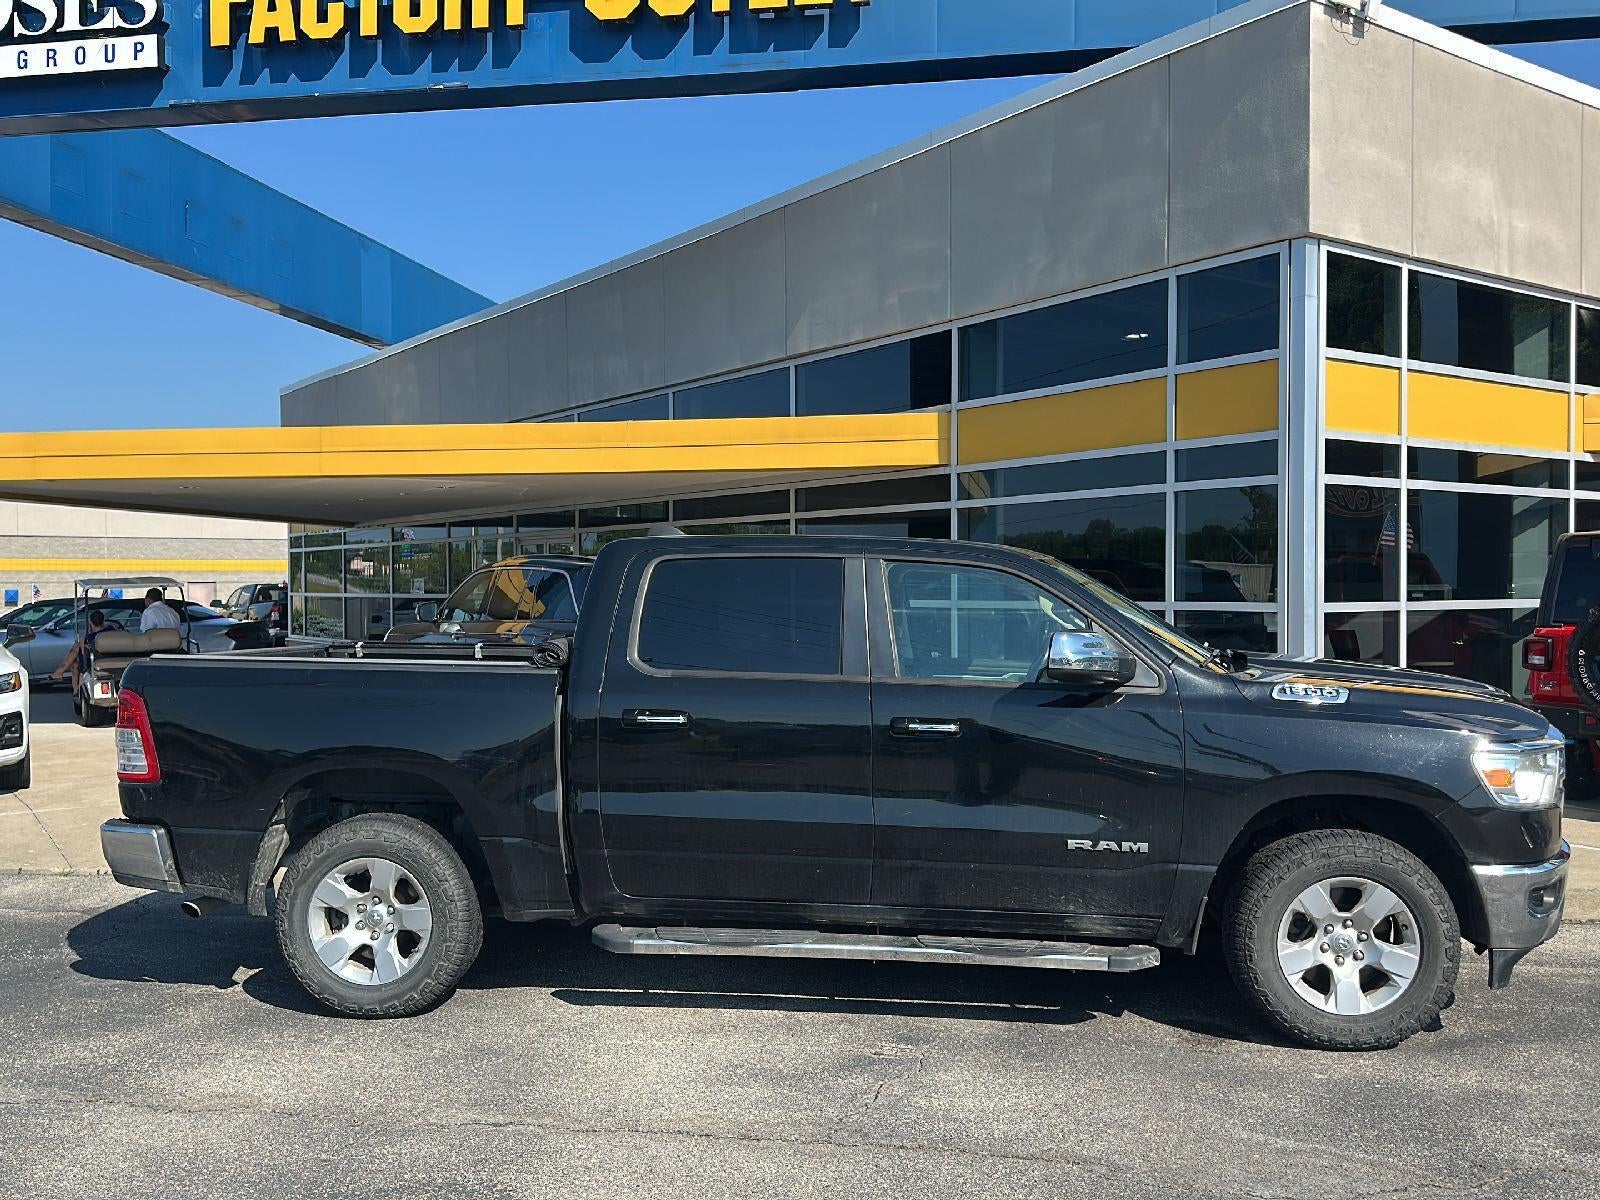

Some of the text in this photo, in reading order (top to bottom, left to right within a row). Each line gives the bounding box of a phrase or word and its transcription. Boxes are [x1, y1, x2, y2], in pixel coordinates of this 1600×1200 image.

[209, 0, 524, 47] FACTO
[16, 41, 146, 70] GROUP
[1066, 839, 1149, 853] RAM
